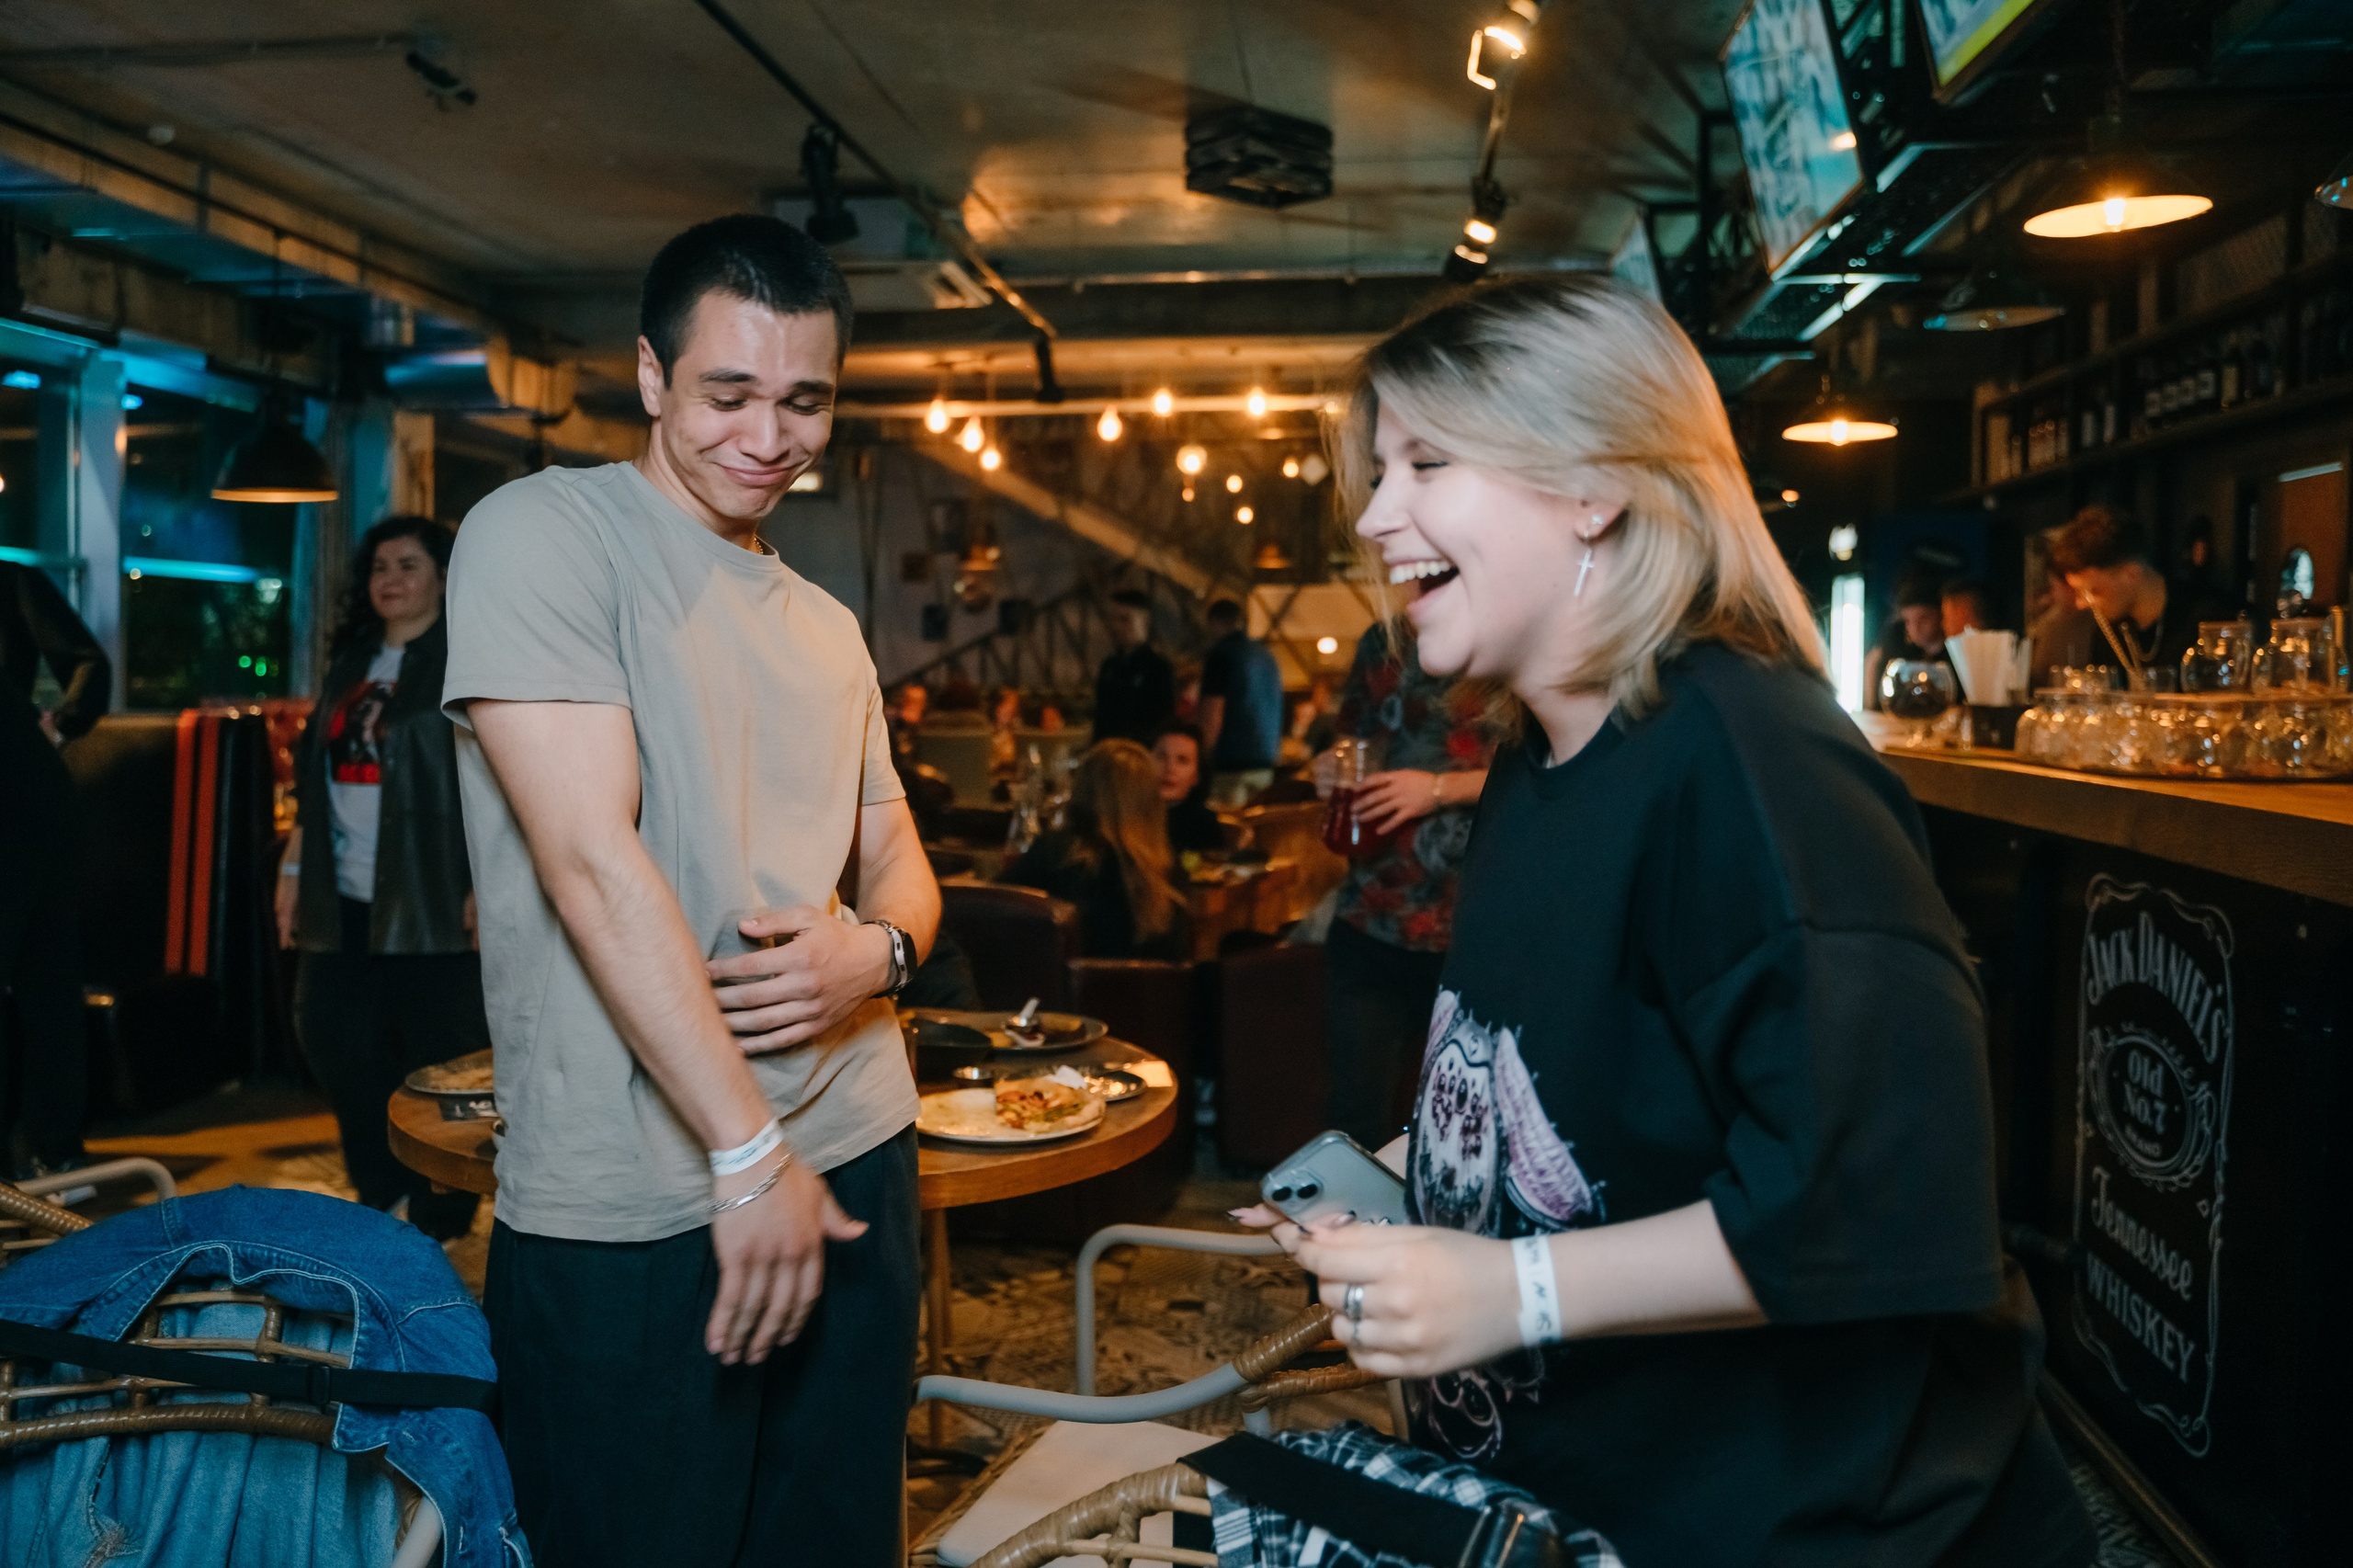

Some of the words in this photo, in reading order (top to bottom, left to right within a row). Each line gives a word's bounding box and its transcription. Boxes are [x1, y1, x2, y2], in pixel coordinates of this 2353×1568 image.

[2128, 1049, 2165, 1098] Old
[2091, 1165, 2192, 1301] Tennessee
[2086, 1250, 2196, 1383] WHISKEY
